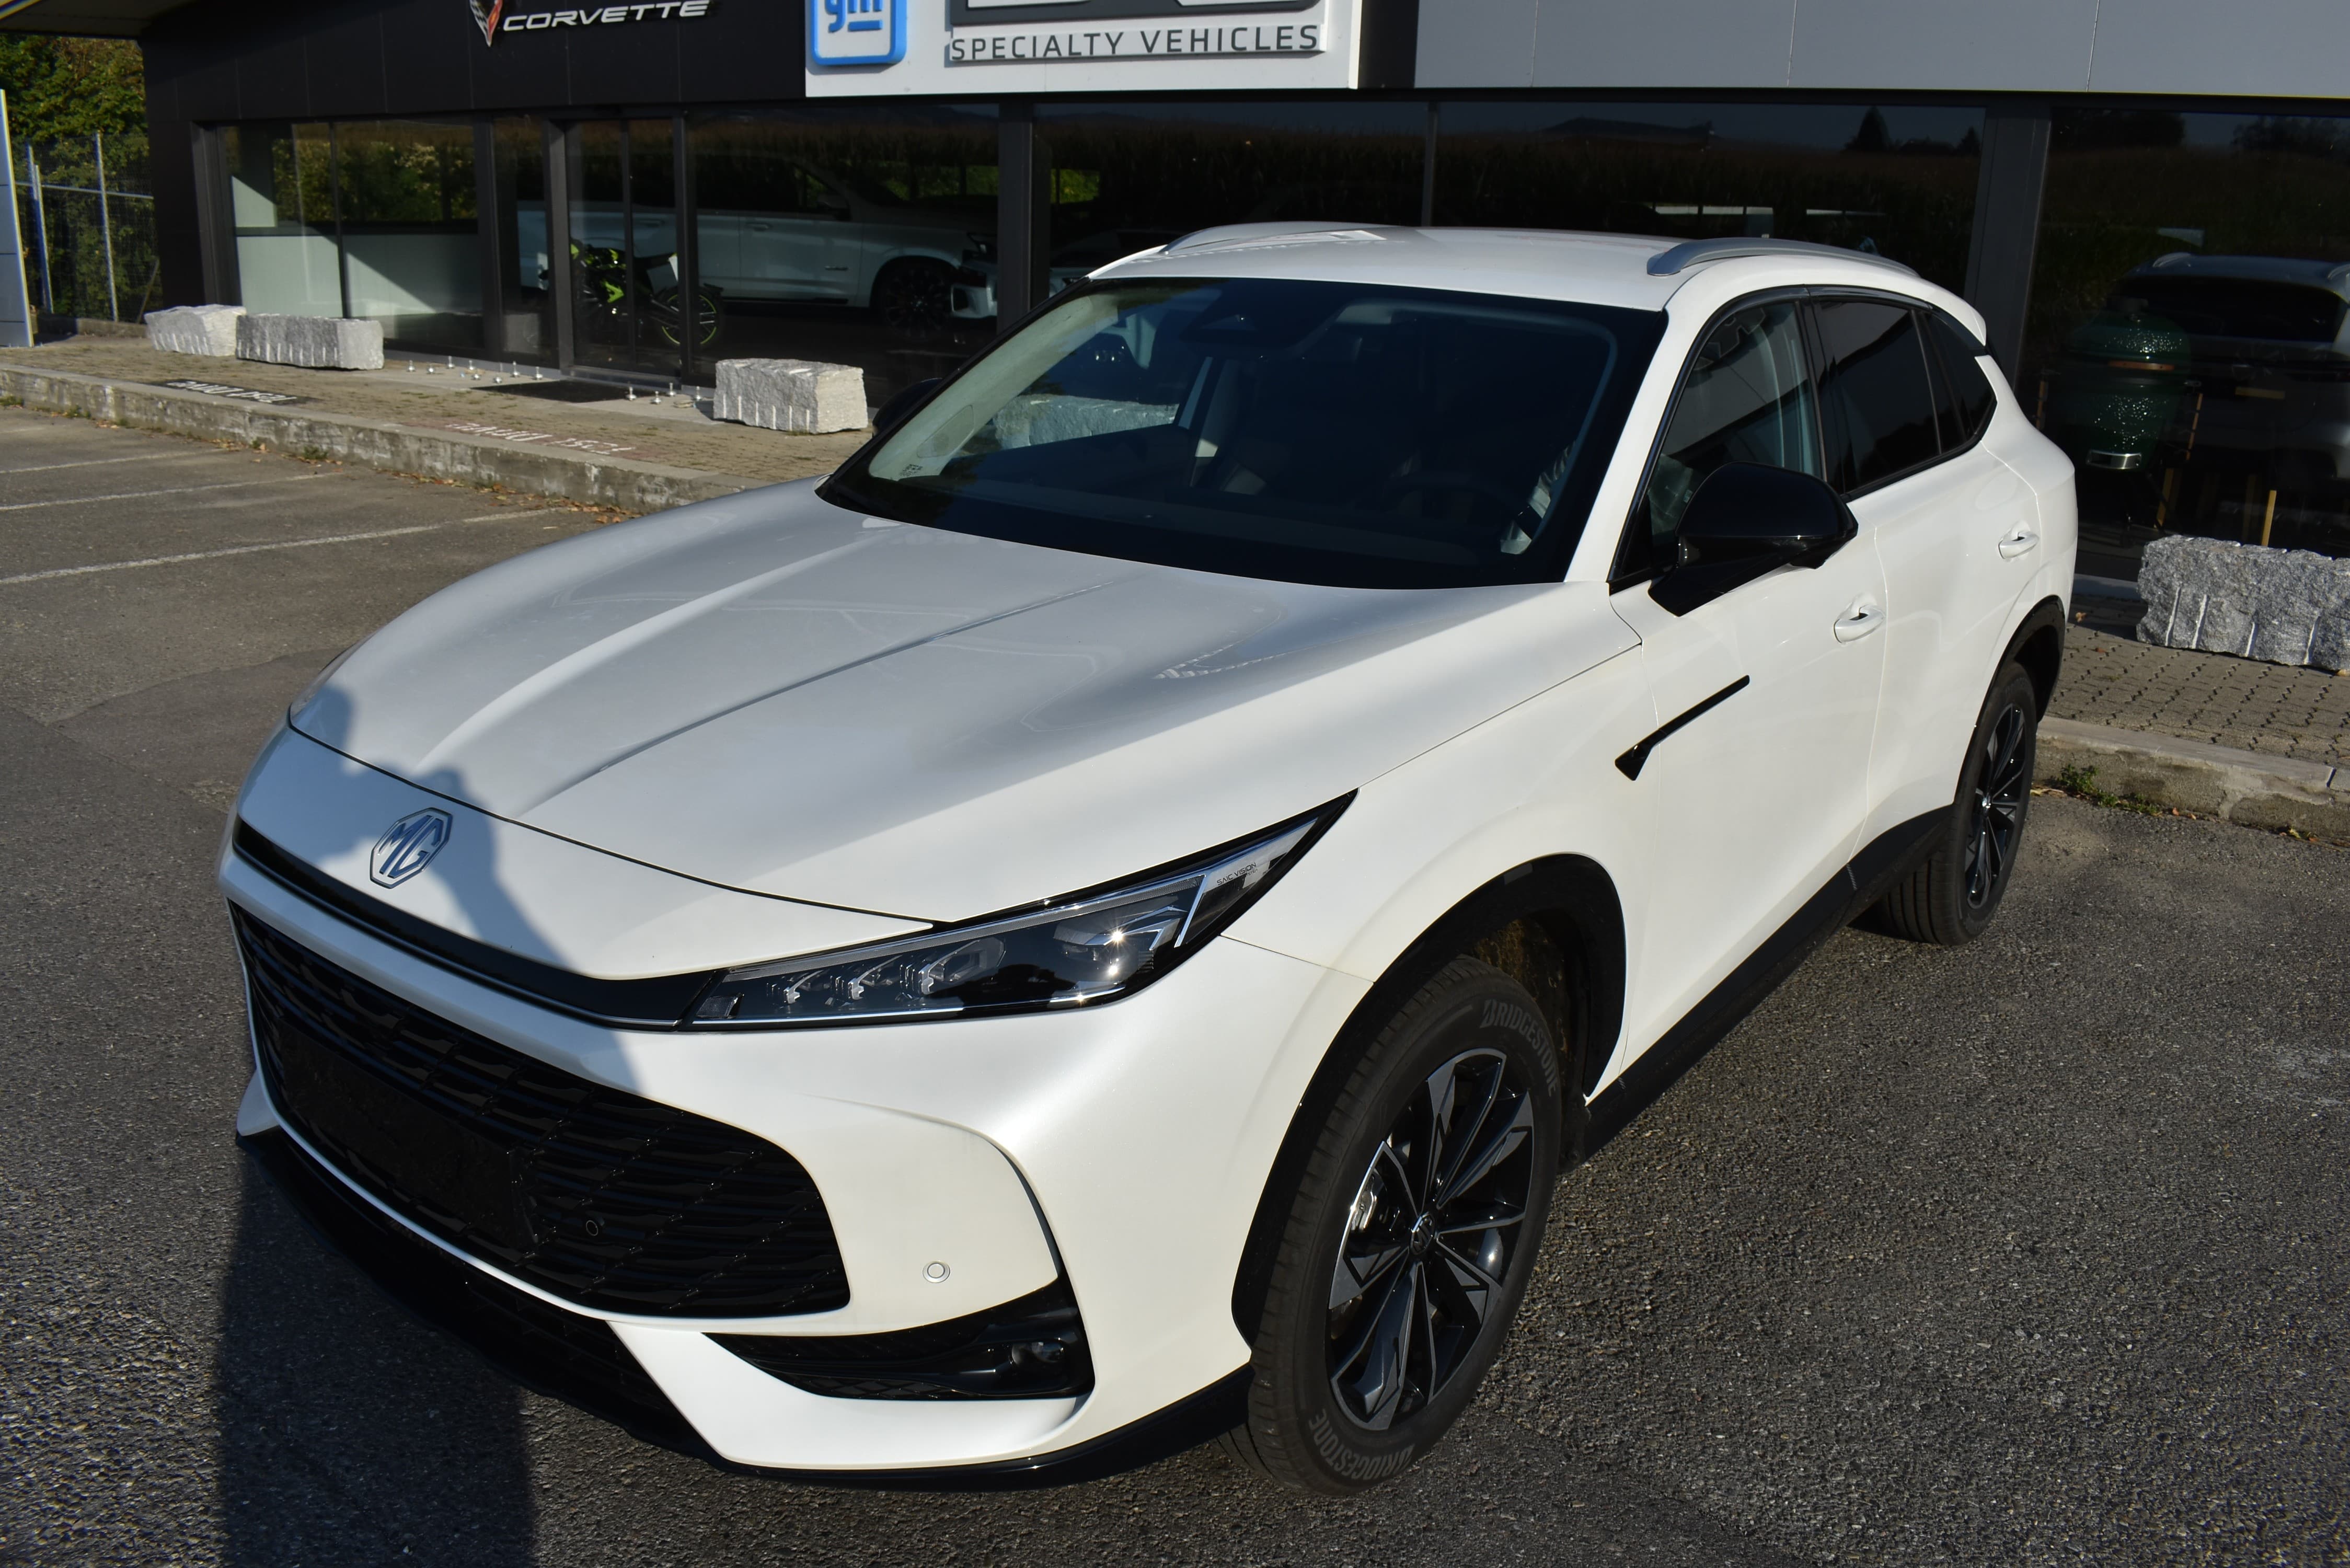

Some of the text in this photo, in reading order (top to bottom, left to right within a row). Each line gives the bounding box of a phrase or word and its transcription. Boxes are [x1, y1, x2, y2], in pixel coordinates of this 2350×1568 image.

[503, 0, 710, 31] CORVETTE
[951, 25, 1318, 60] SPECIALTY VEHICLES
[377, 814, 444, 880] MG
[1479, 998, 1558, 1097] BRIDGESTONE
[1308, 1408, 1415, 1480] BRIDGESTONE
